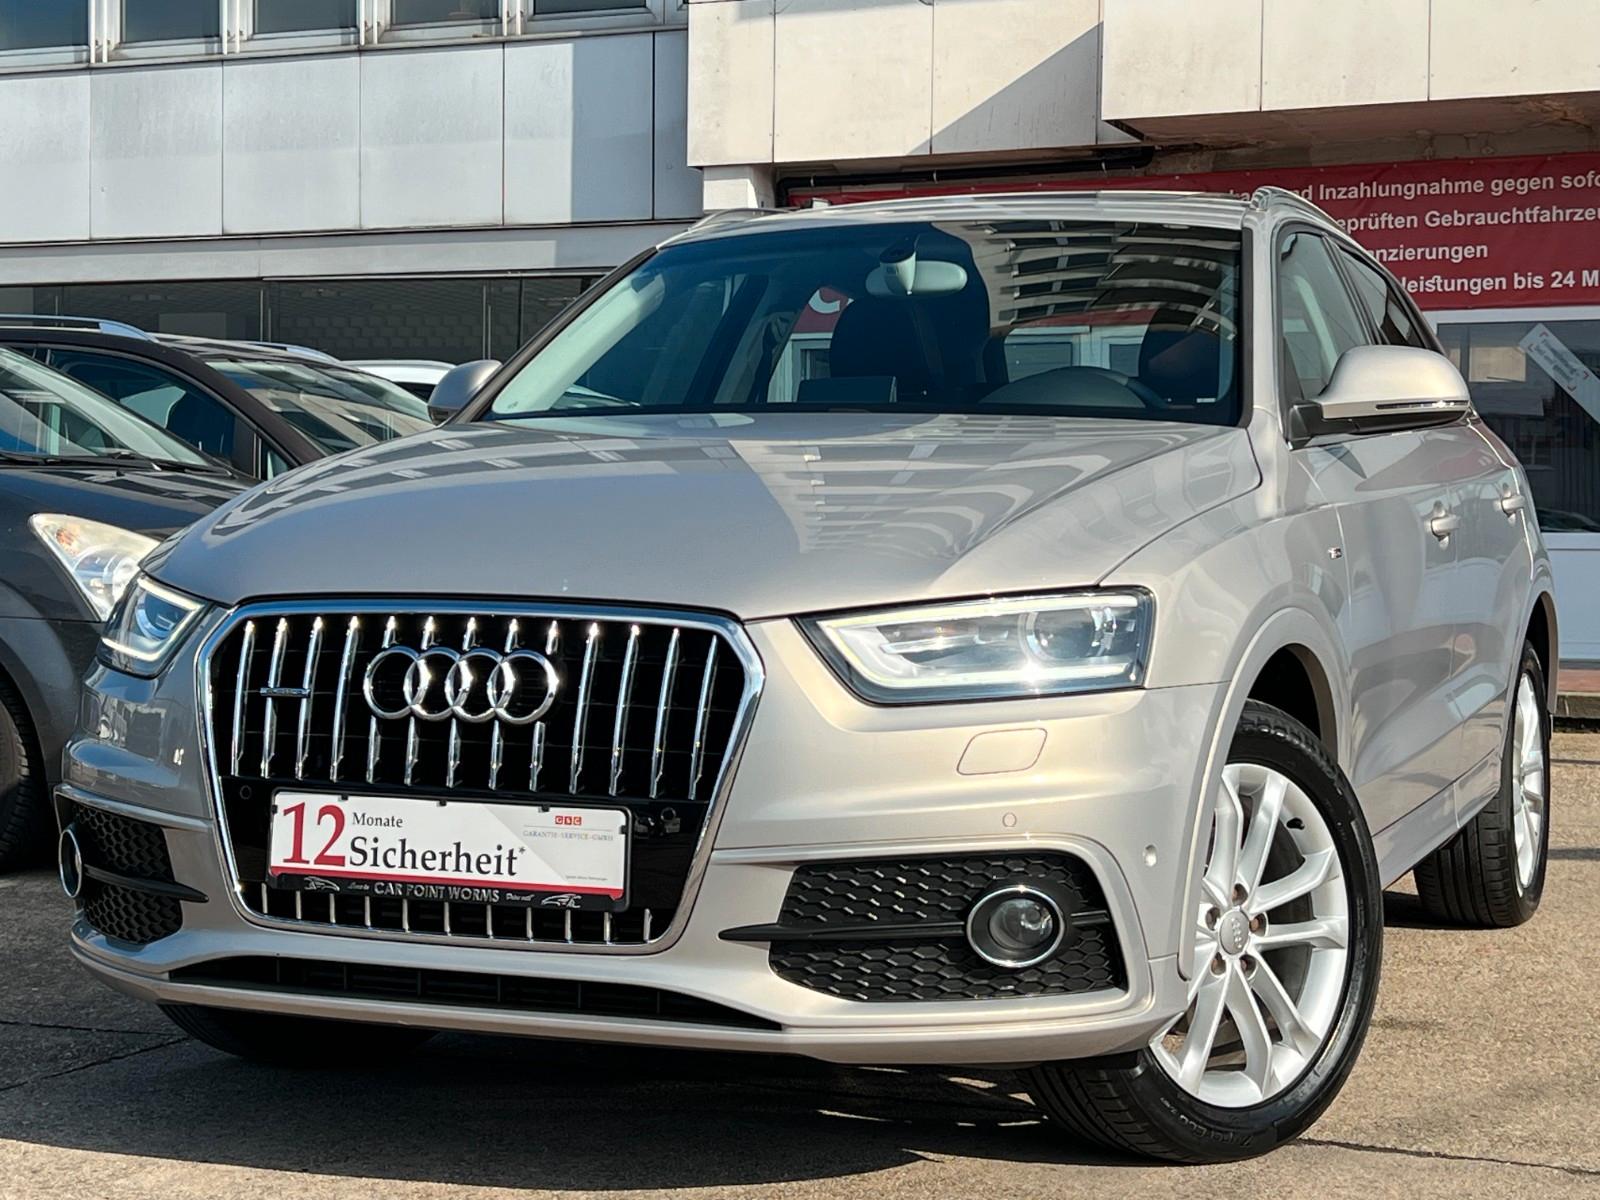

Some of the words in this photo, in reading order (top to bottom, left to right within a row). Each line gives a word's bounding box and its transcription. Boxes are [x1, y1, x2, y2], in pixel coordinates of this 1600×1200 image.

[1319, 177, 1484, 200] Inzahlungnahme
[1491, 176, 1554, 196] gegen
[1336, 211, 1419, 235] eprüften
[1424, 205, 1600, 229] Gebrauchtfahrze
[1367, 244, 1488, 264] nzierungen
[1401, 275, 1507, 295] leistungen
[1513, 272, 1544, 289] bis
[1550, 271, 1576, 288] 24
[352, 812, 403, 828] Monate
[283, 801, 346, 867] 12
[374, 882, 402, 896] CAR
[406, 884, 446, 899] POINT
[449, 886, 500, 902] WORMS
